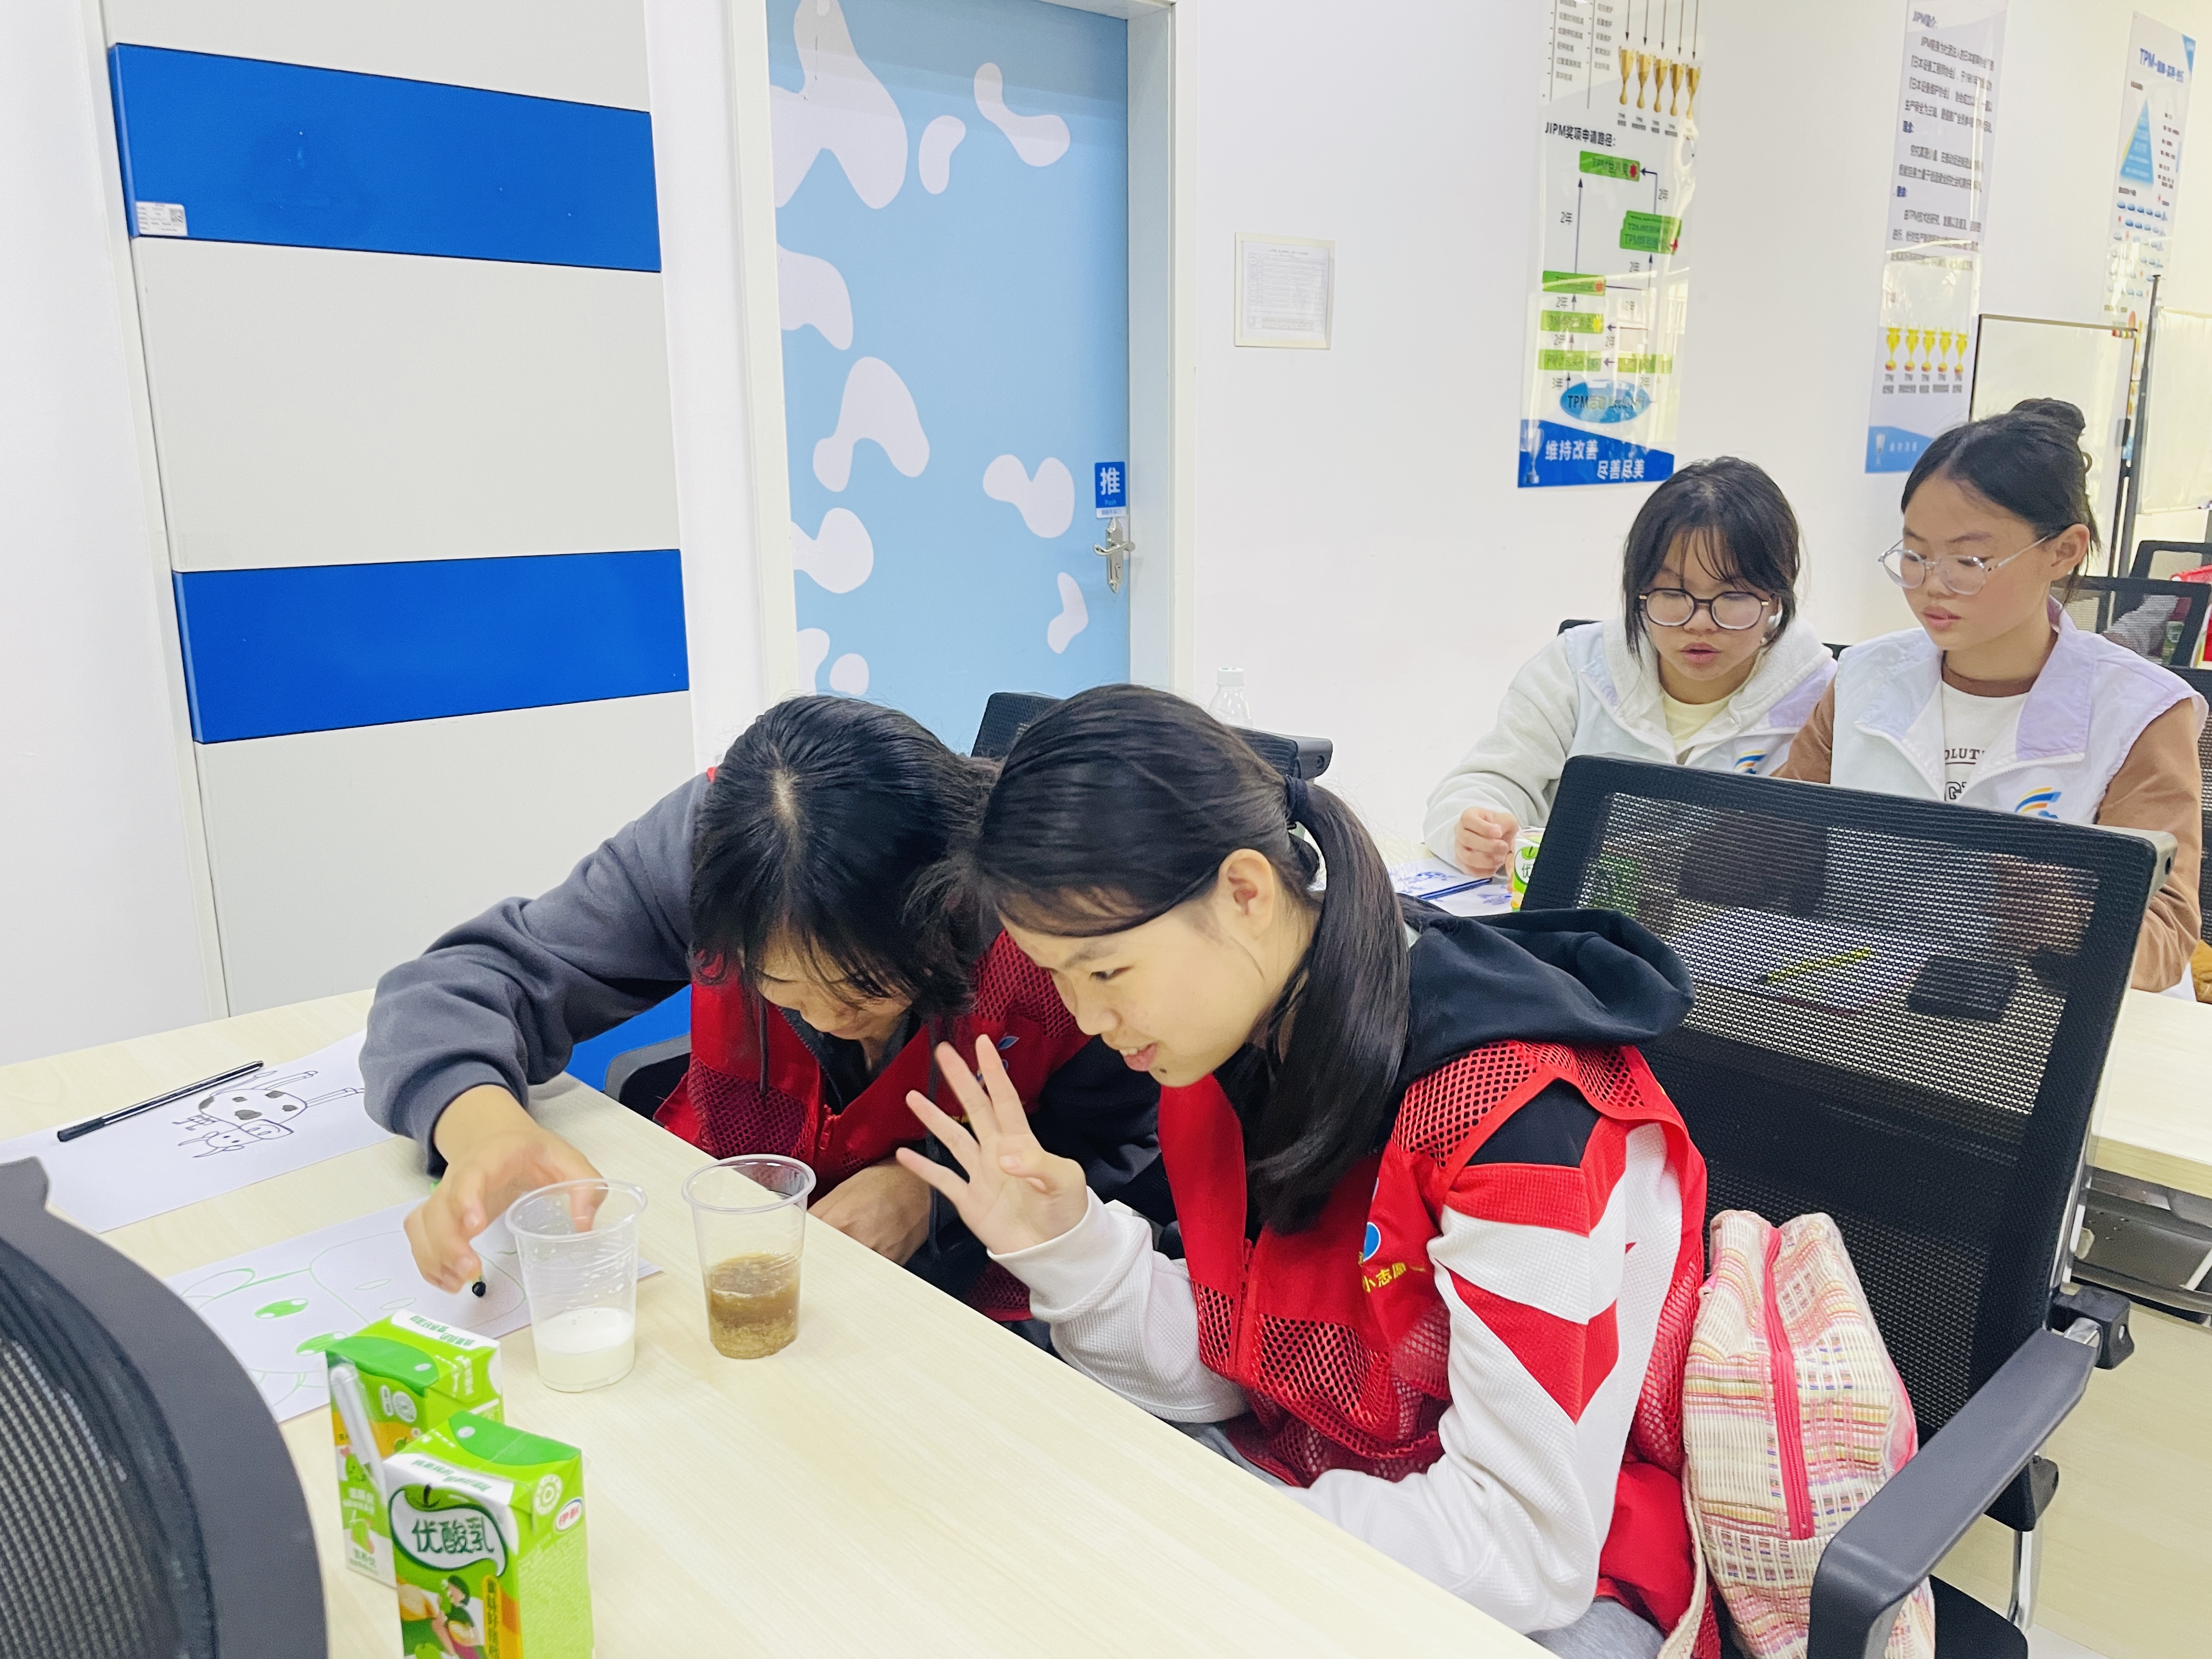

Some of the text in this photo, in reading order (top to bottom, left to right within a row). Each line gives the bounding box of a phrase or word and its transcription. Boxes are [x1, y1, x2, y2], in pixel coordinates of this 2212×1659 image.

[1560, 212, 1572, 225] 2年
[1556, 296, 1568, 309] 2年
[1545, 439, 1599, 461] 维持改善
[1100, 467, 1120, 495] 推
[1522, 863, 1534, 878] 优
[1362, 1262, 1425, 1293] 小志愿
[558, 1504, 580, 1526] 伊利
[412, 1515, 494, 1554] 优酸乳
